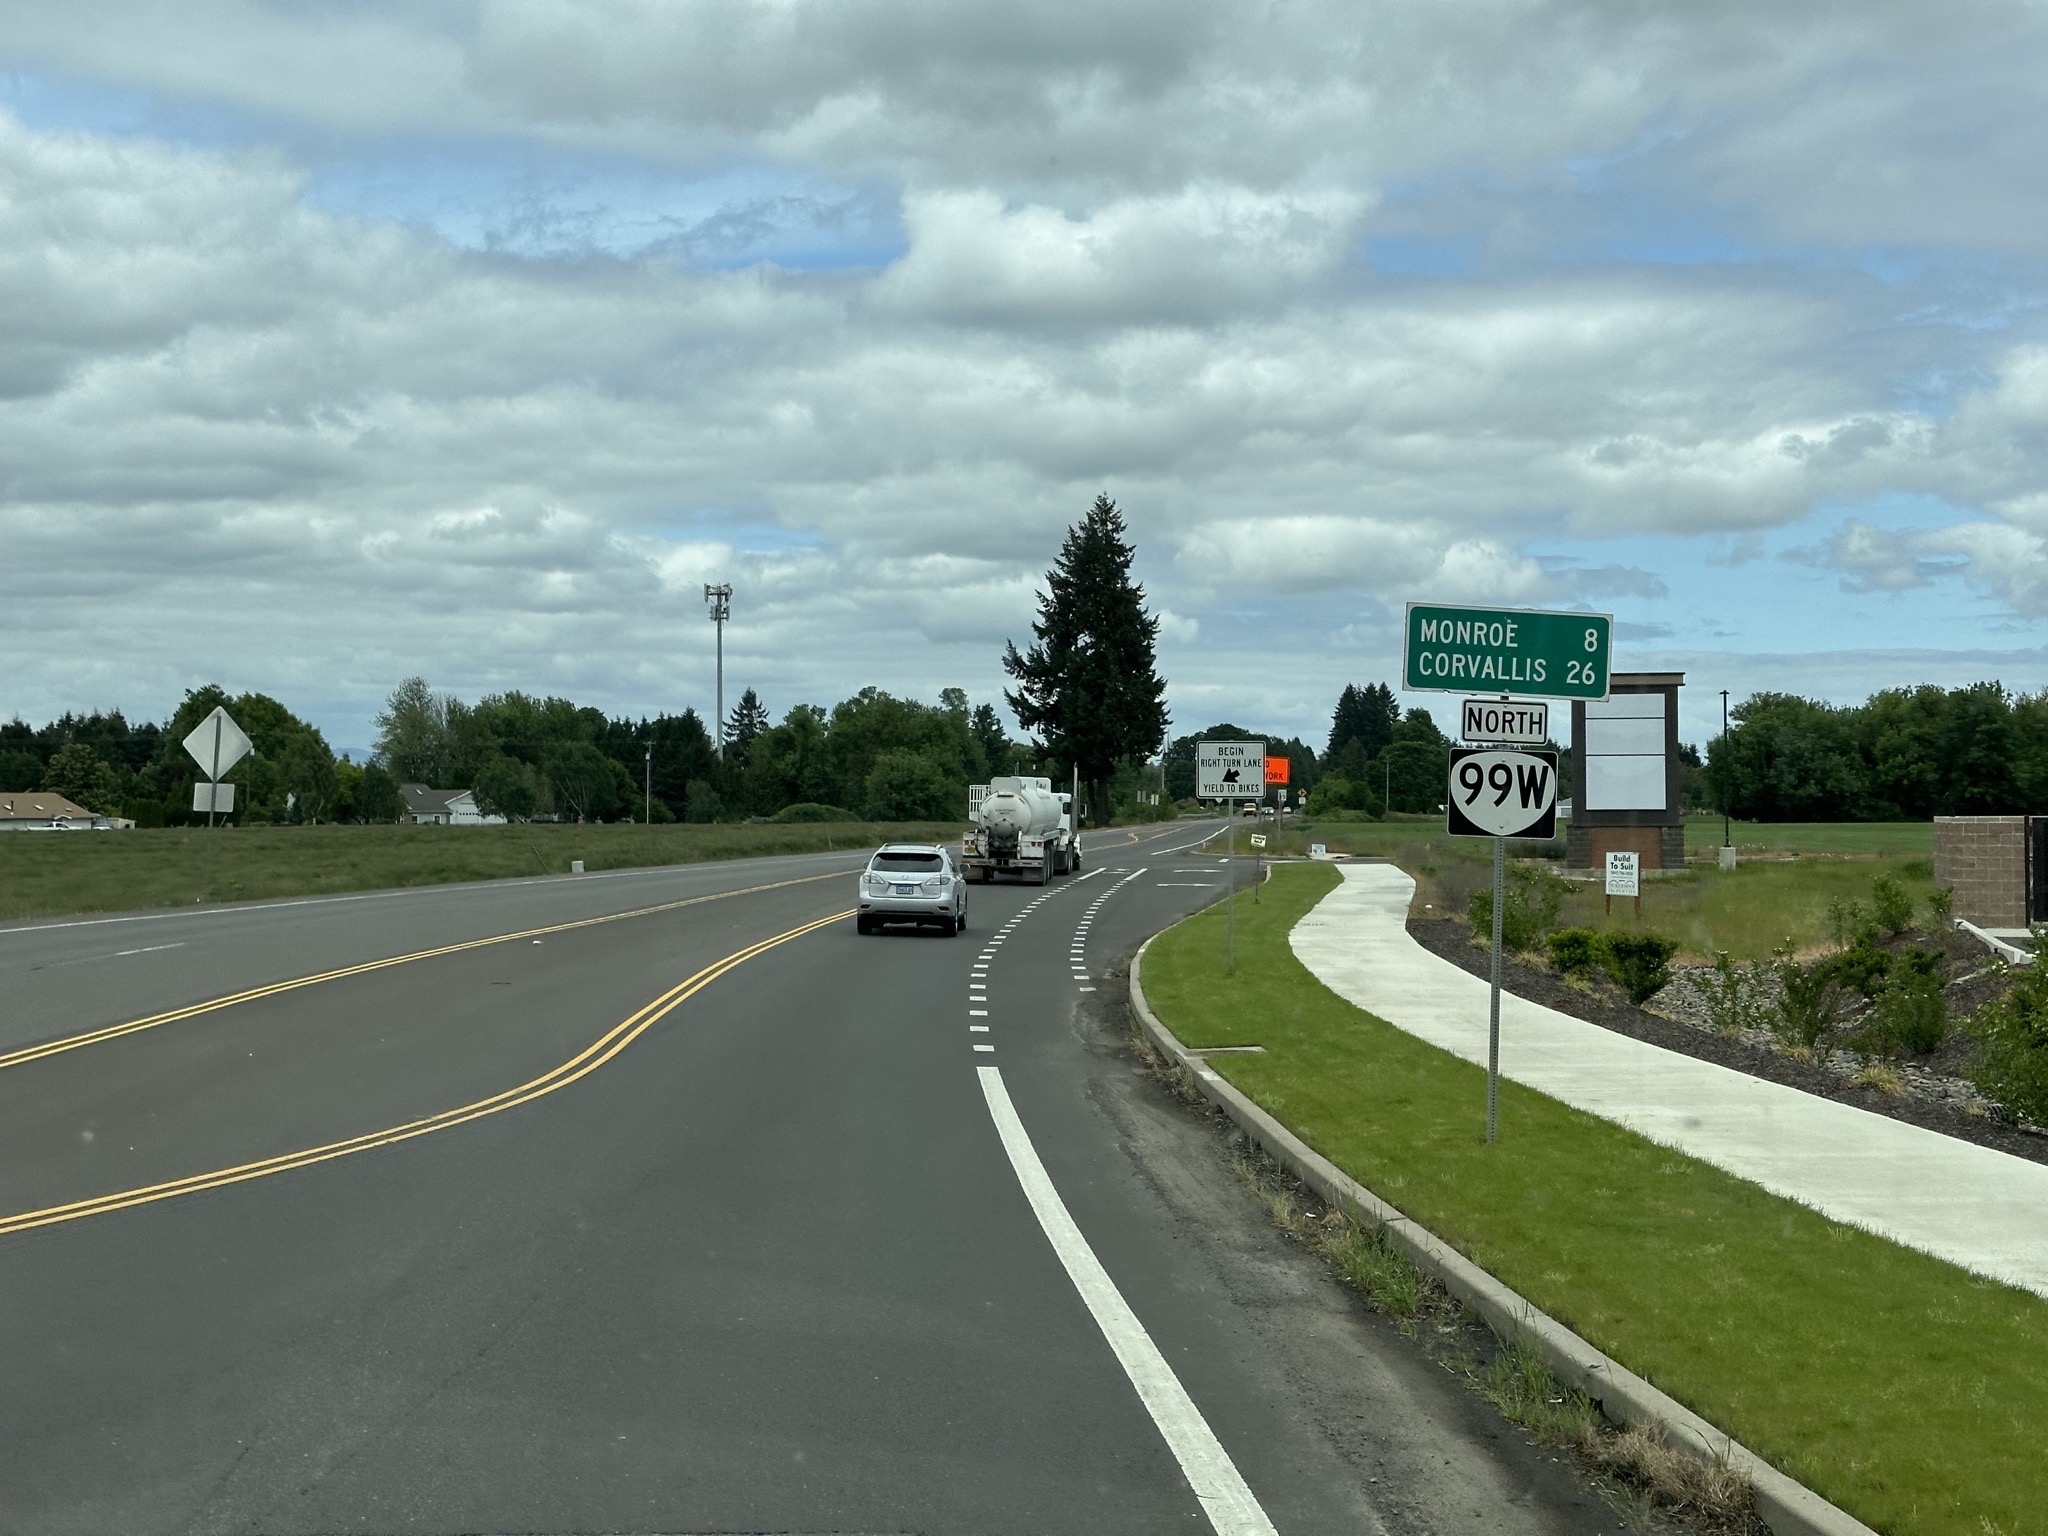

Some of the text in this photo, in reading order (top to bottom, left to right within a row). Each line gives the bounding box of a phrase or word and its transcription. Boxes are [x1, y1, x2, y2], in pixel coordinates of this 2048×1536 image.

[1420, 618, 1598, 652] MONROE 8
[1419, 652, 1596, 685] CORVALLIS 26
[1467, 707, 1543, 735] NORTH
[1200, 758, 1220, 767] RIGHT
[1222, 759, 1241, 767] TURN
[1244, 759, 1262, 768] LANE
[1218, 747, 1244, 756] BEGIN
[1203, 784, 1259, 793] YIELD TO BIKES
[1459, 762, 1549, 809] 99W
